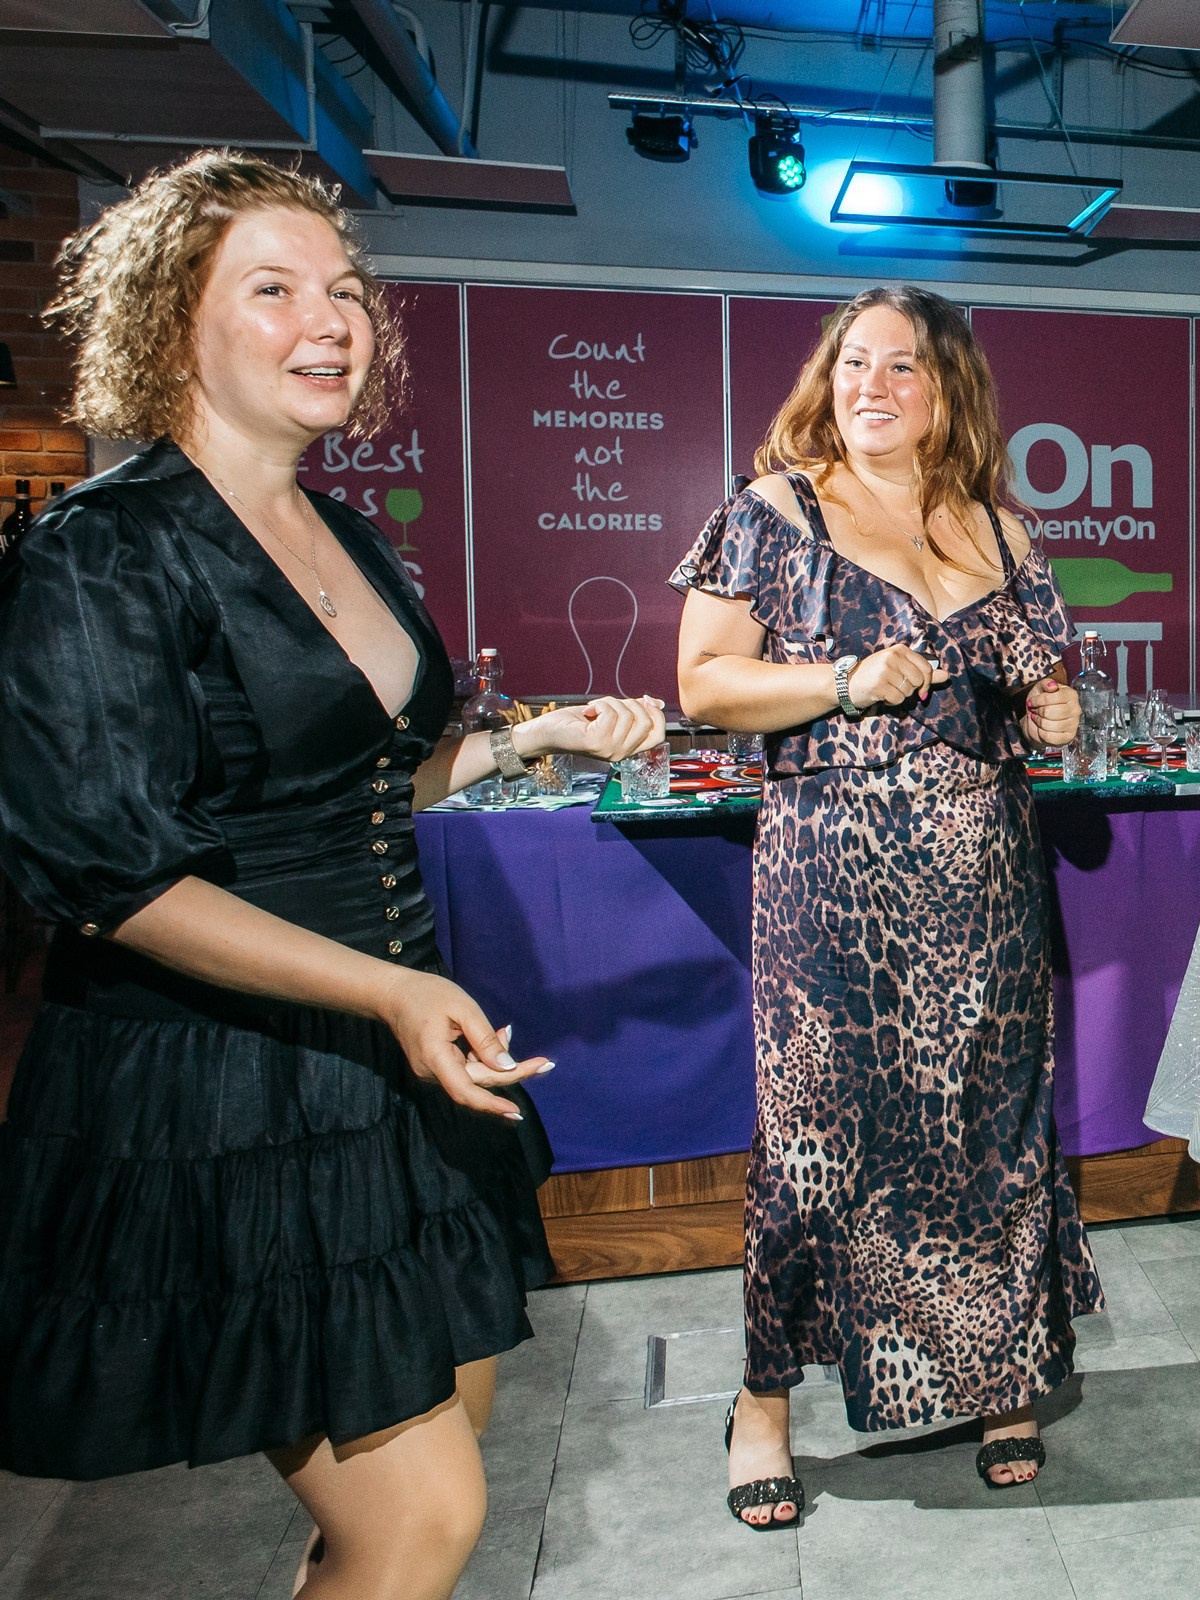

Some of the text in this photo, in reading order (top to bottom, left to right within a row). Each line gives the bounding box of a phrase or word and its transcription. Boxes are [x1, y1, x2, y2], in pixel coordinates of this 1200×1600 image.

[548, 332, 646, 363] Count
[569, 370, 627, 400] the
[533, 410, 664, 430] MEMORIES
[322, 429, 425, 473] Best
[575, 435, 624, 466] not
[1006, 422, 1153, 510] On
[571, 472, 629, 501] the
[538, 512, 663, 531] CALORIES
[1013, 513, 1156, 546] ventyOn
